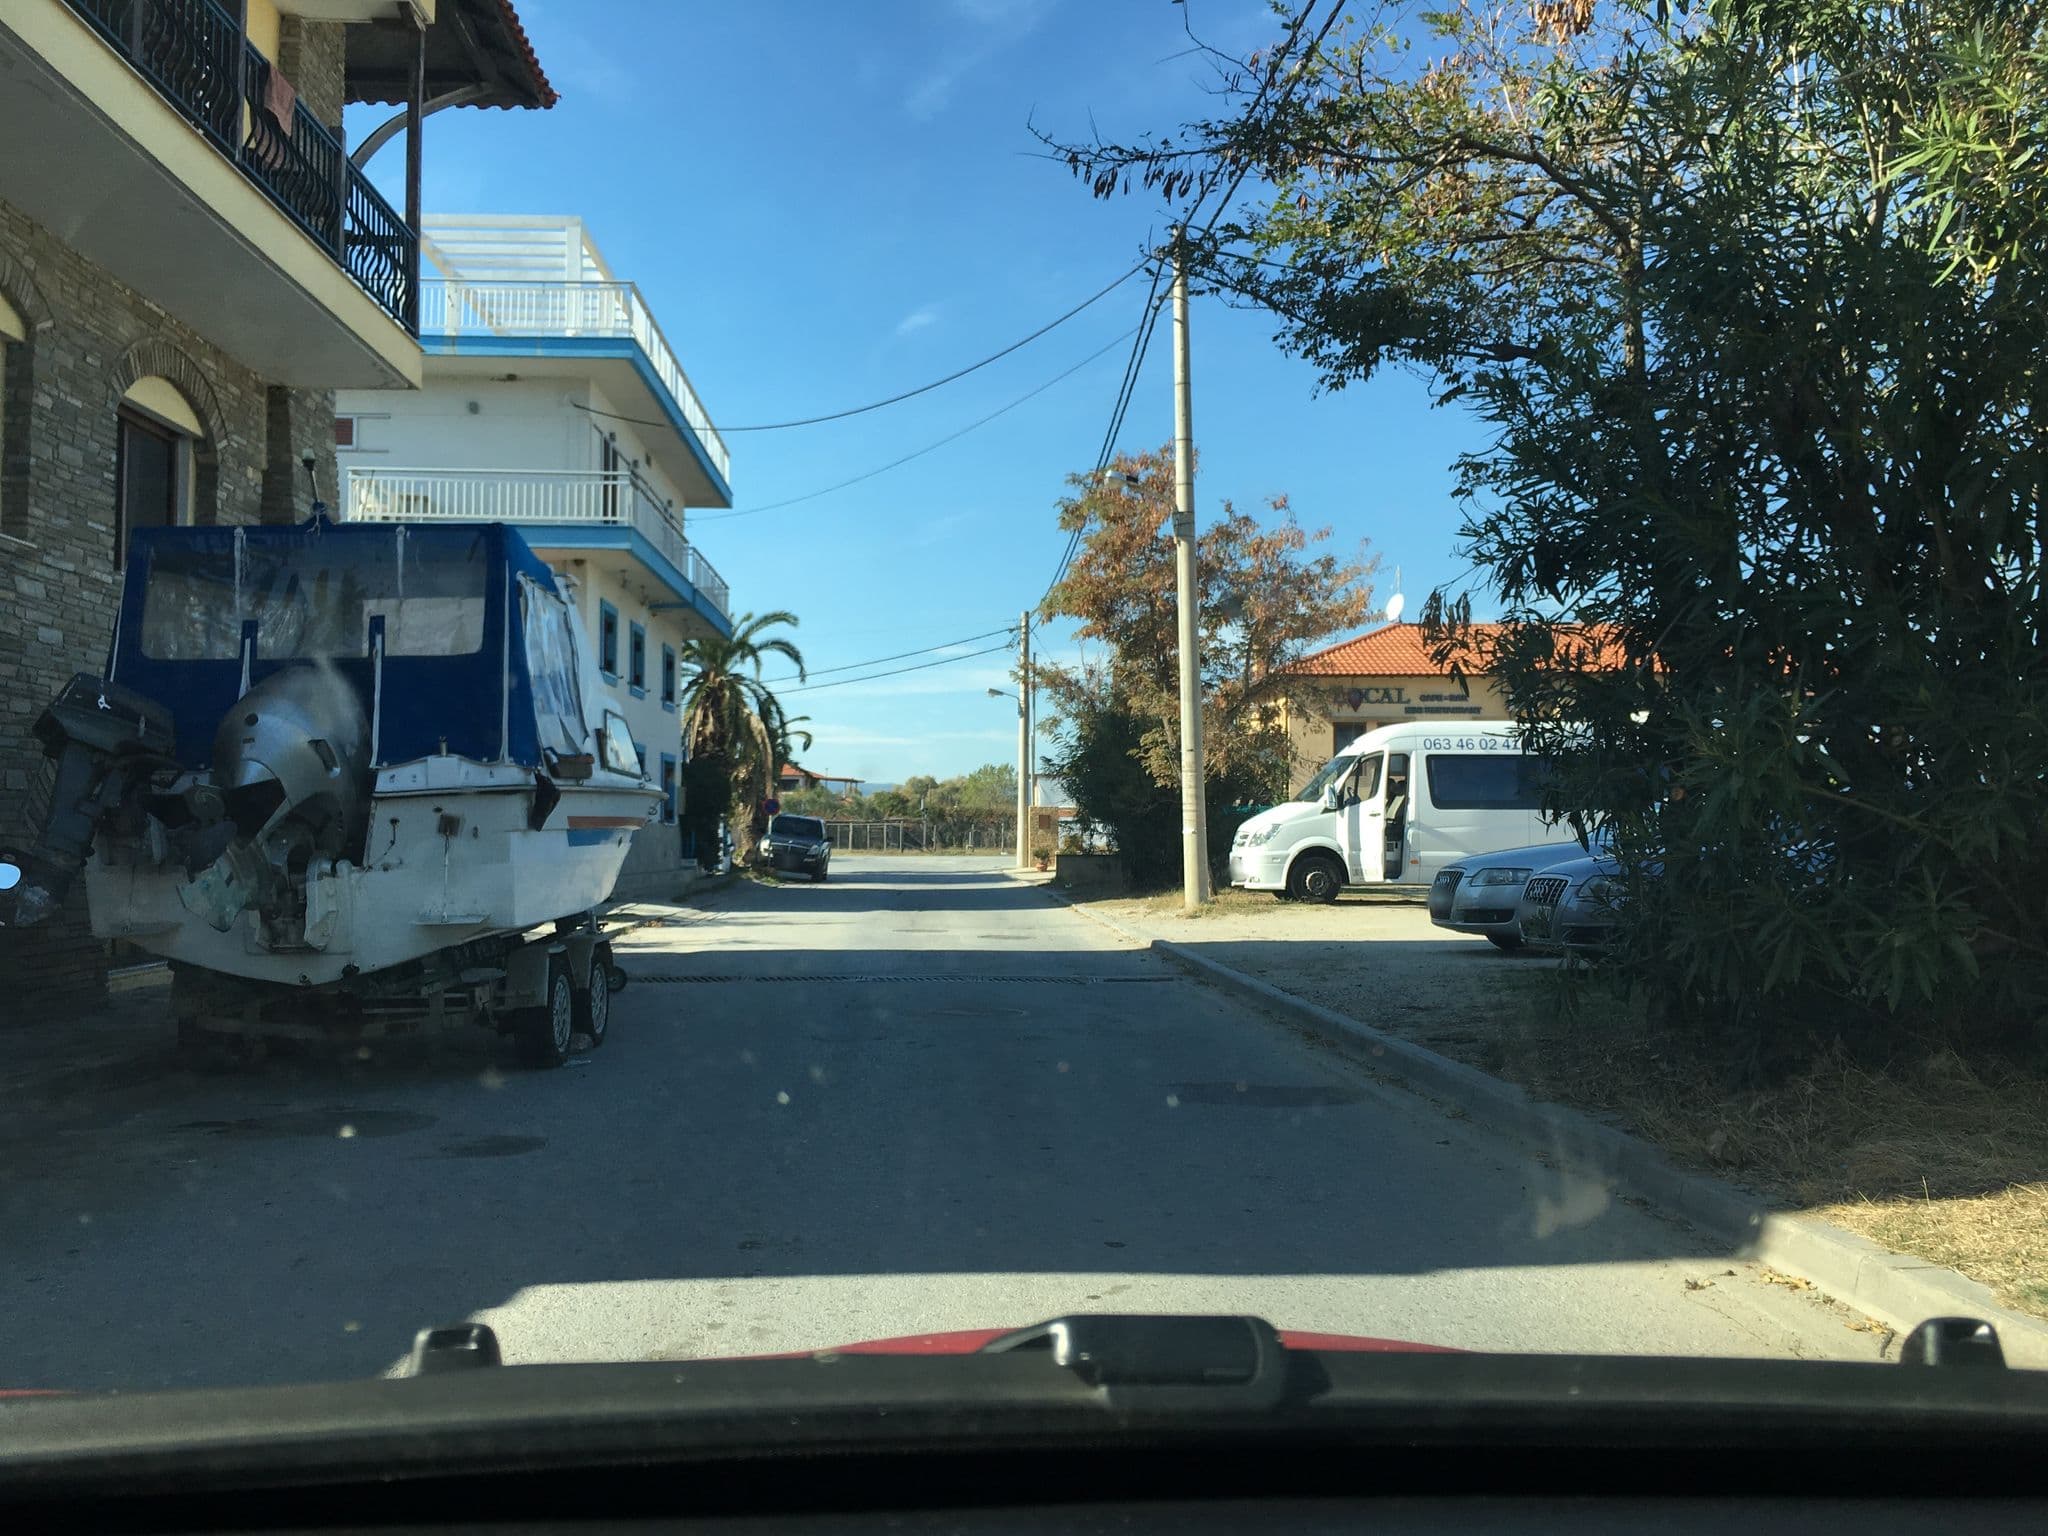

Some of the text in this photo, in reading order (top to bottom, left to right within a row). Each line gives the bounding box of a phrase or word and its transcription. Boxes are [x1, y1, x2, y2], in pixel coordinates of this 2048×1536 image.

[1423, 737, 1452, 751] 063
[1456, 737, 1475, 751] 46
[1479, 737, 1498, 751] 02
